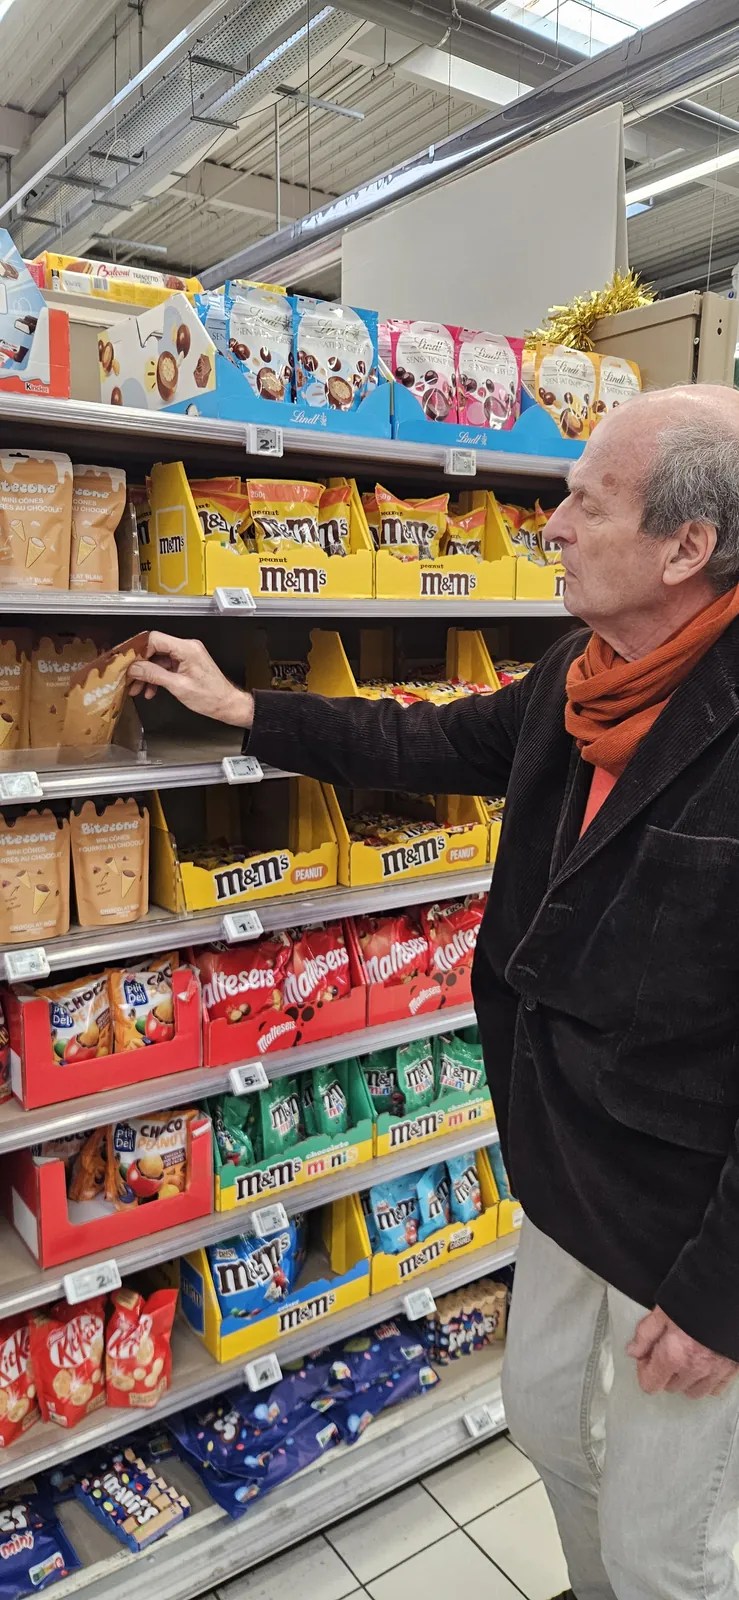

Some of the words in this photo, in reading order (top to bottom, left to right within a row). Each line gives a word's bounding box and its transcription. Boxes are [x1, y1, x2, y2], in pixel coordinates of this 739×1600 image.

[603, 370, 626, 385] Lindt
[290, 410, 320, 425] Lindt
[456, 431, 482, 445] Lindt
[258, 556, 288, 564] peanut
[260, 566, 327, 593] m&m's
[420, 571, 477, 596] m&m's
[81, 820, 139, 835] Bitecone
[382, 835, 446, 876] m&m's
[450, 846, 475, 861] PEANUT
[214, 853, 289, 900] m&m's
[295, 865, 324, 881] PEANUT
[257, 1020, 297, 1054] Maltesers
[389, 1111, 445, 1147] m&m's
[116, 1138, 135, 1151] Deli
[235, 1158, 302, 1201] m&m's
[216, 1235, 290, 1295] m&m's
[399, 1239, 446, 1278] m&m's
[279, 1294, 335, 1332] m&m's
